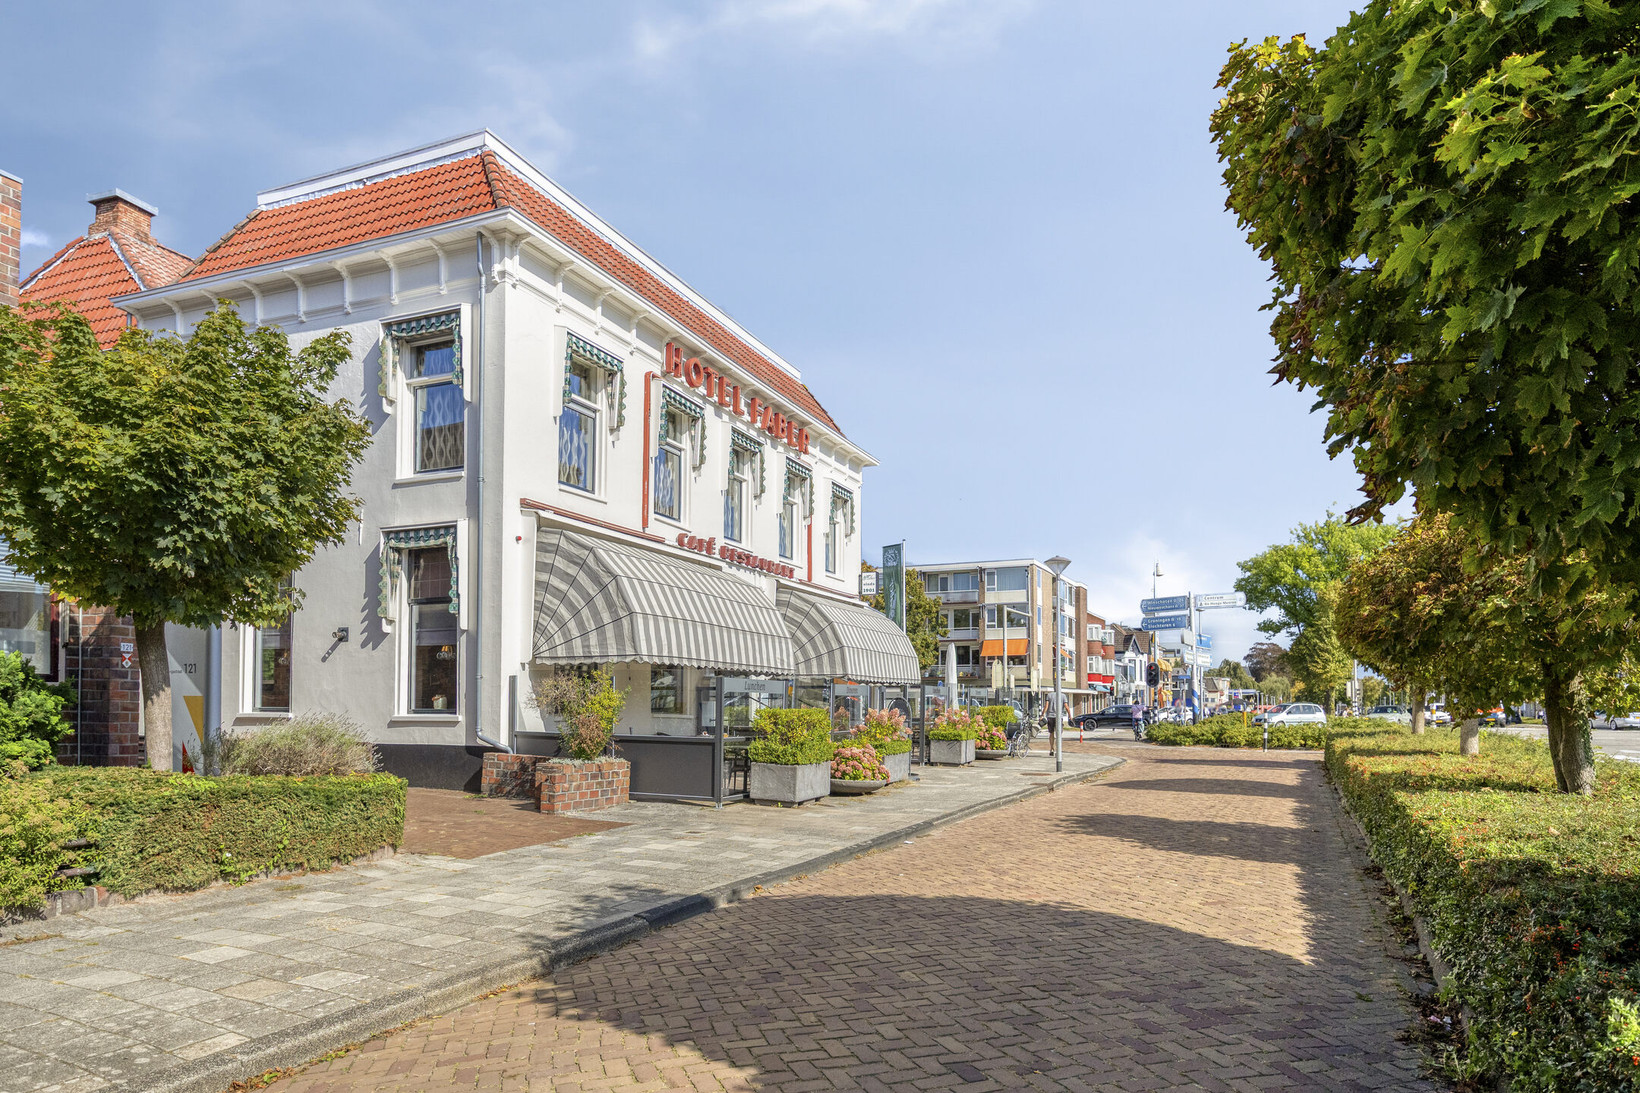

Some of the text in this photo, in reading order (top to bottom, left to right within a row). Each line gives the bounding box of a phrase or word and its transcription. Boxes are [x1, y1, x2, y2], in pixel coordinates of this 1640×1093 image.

[665, 342, 810, 455] HOTEL FABER
[183, 663, 197, 674] 121
